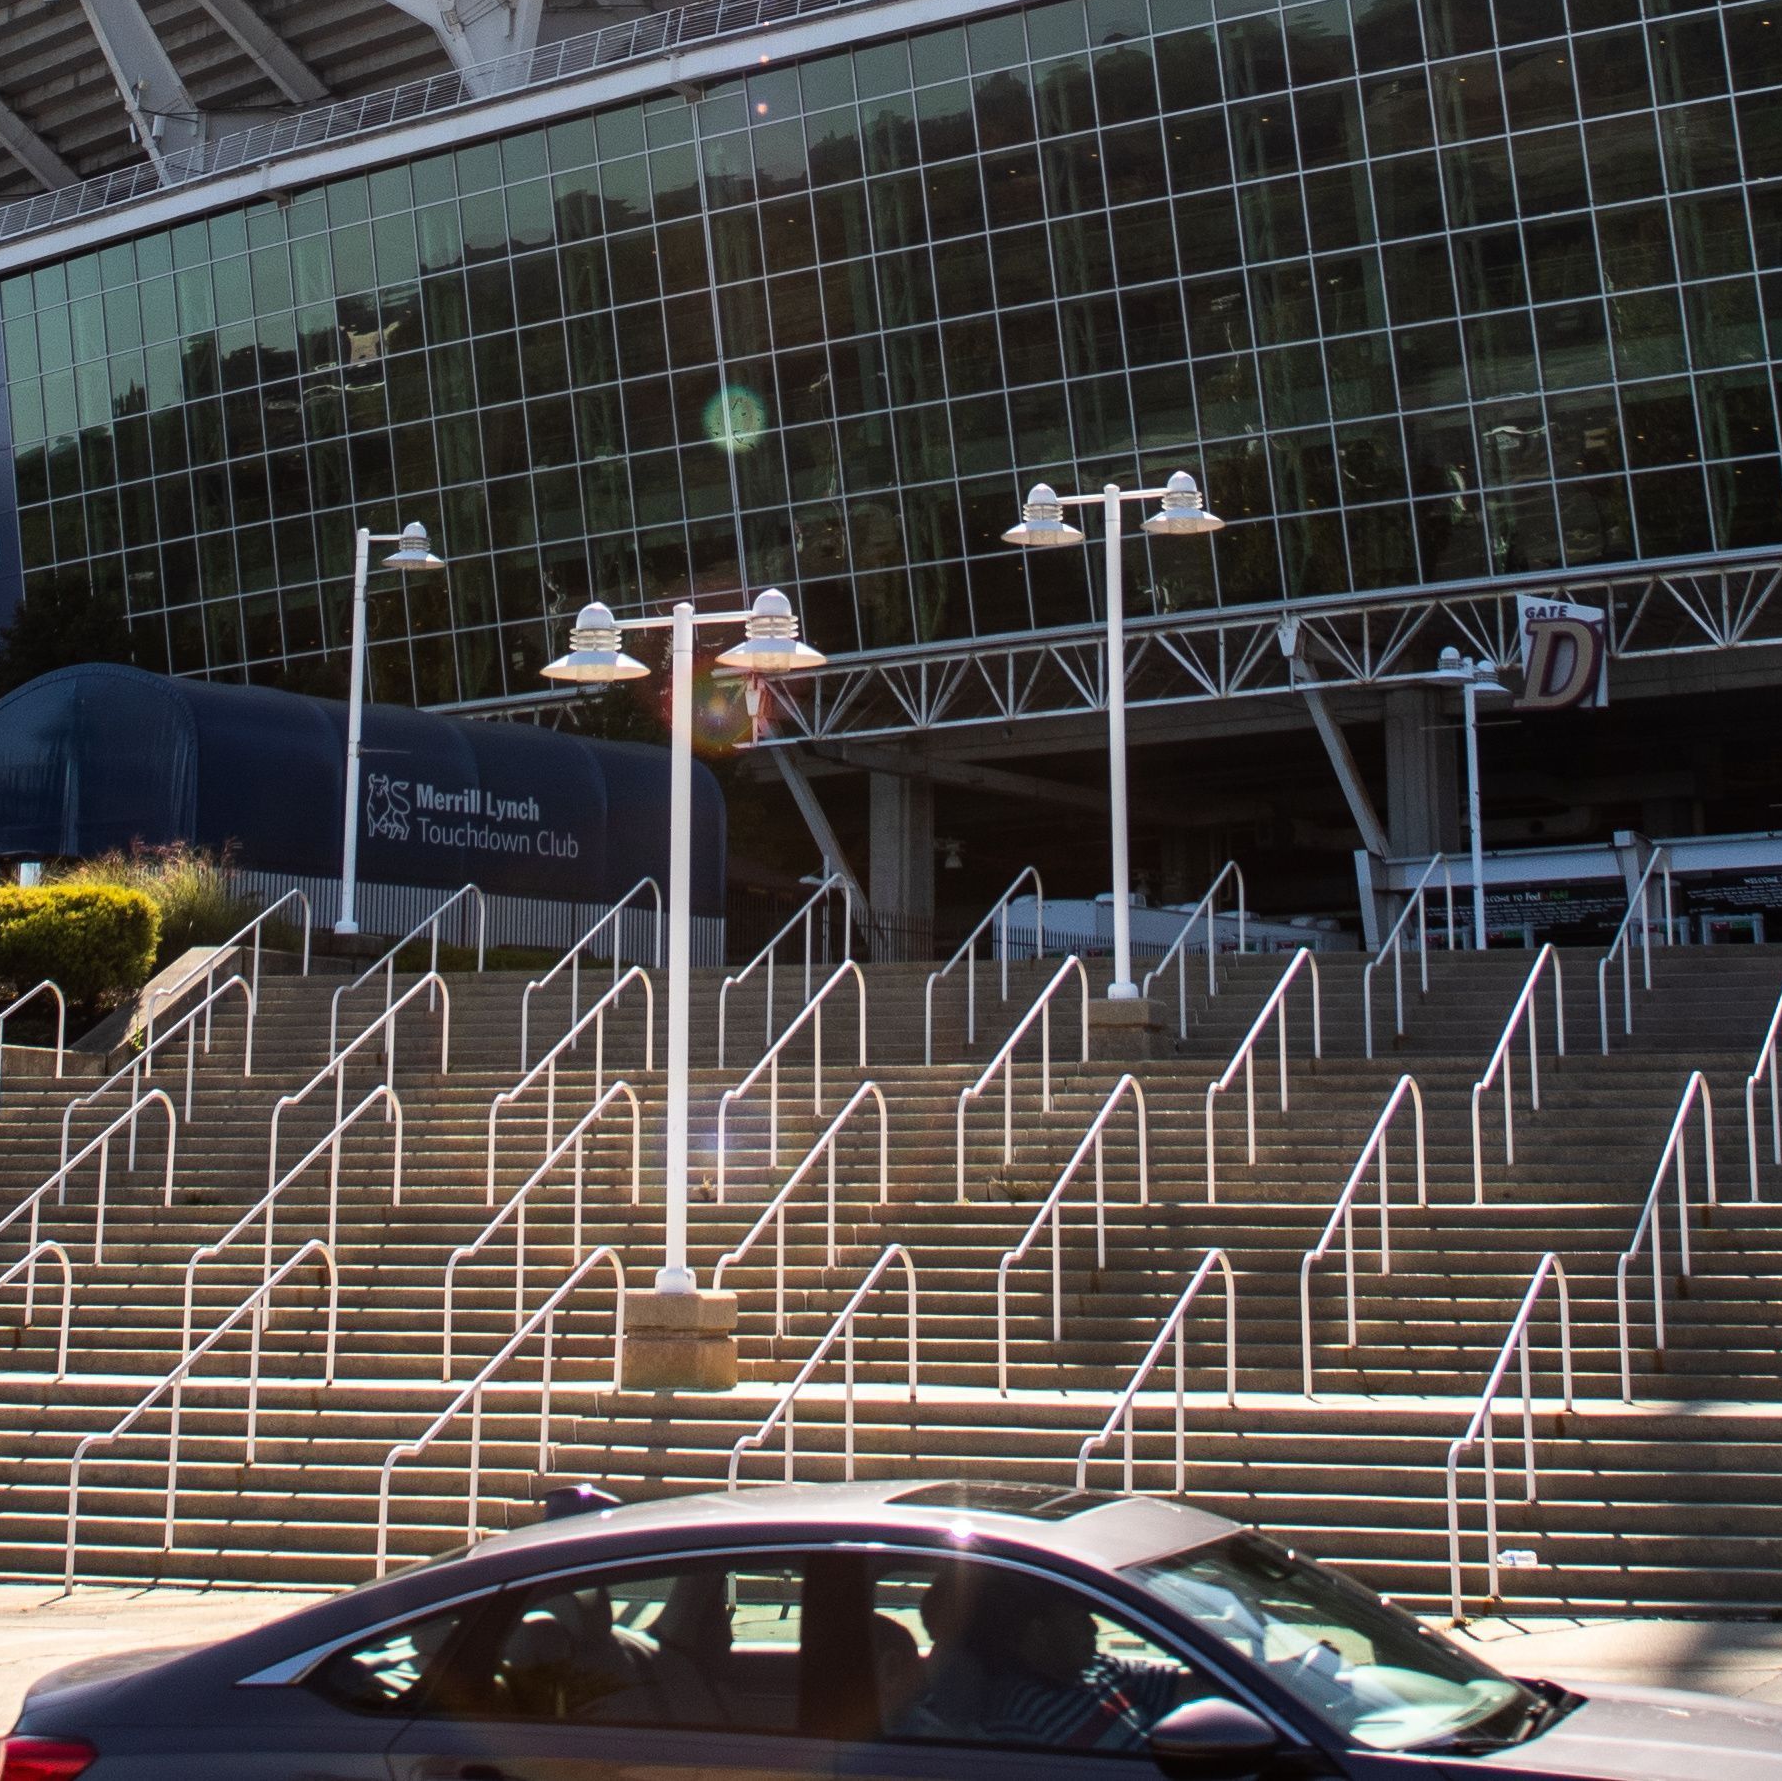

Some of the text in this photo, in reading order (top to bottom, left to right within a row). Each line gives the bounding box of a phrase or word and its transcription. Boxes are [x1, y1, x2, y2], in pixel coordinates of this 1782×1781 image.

[1524, 605, 1568, 619] GATE
[1512, 618, 1603, 711] D
[416, 784, 539, 821] Merrill Lynch
[417, 817, 579, 858] Touchdown Club
